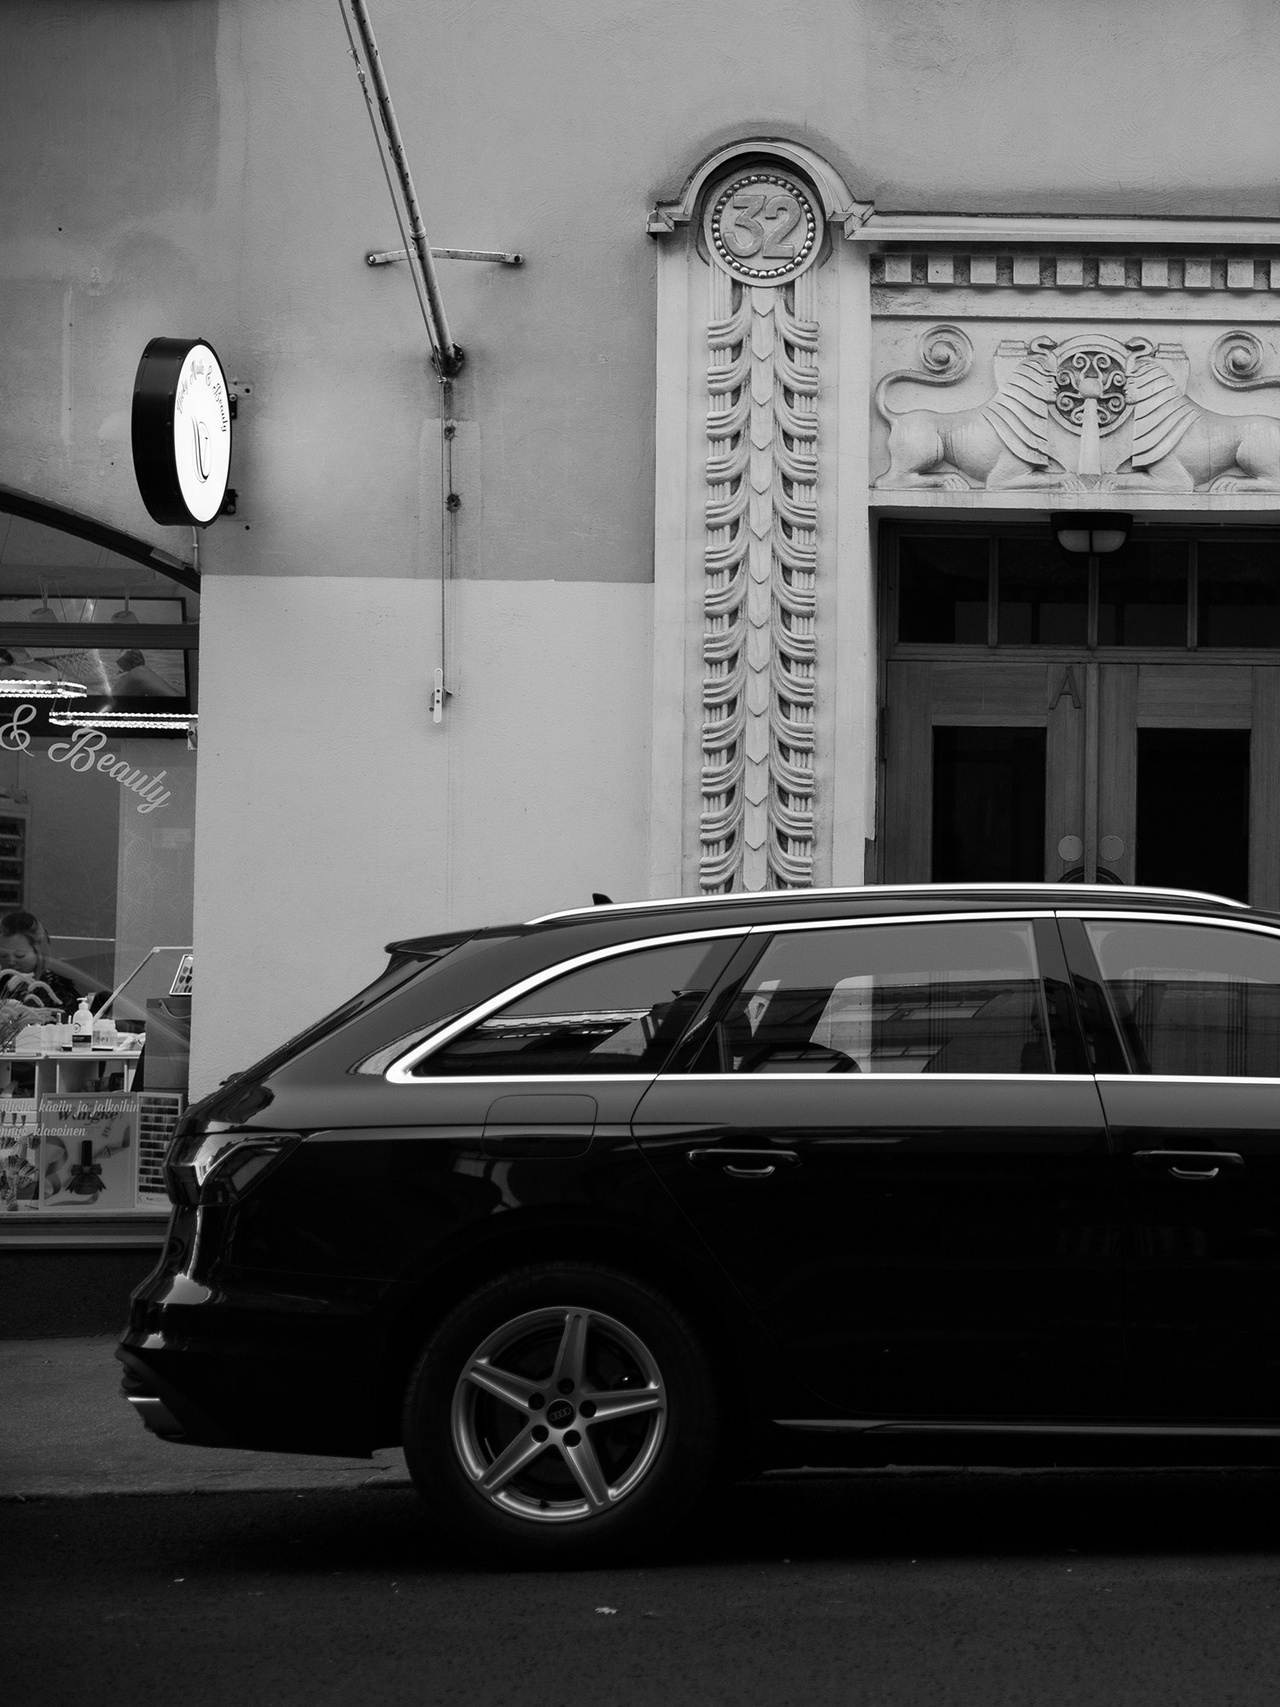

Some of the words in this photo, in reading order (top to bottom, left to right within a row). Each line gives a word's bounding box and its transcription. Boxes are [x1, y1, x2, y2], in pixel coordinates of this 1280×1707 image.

[723, 195, 801, 259] 32
[1049, 665, 1082, 710] A
[0, 704, 35, 757] &
[47, 727, 172, 814] Beauty
[33, 1122, 87, 1137] klassinen
[73, 1100, 89, 1118] ja
[89, 1098, 140, 1118] jalkoihin
